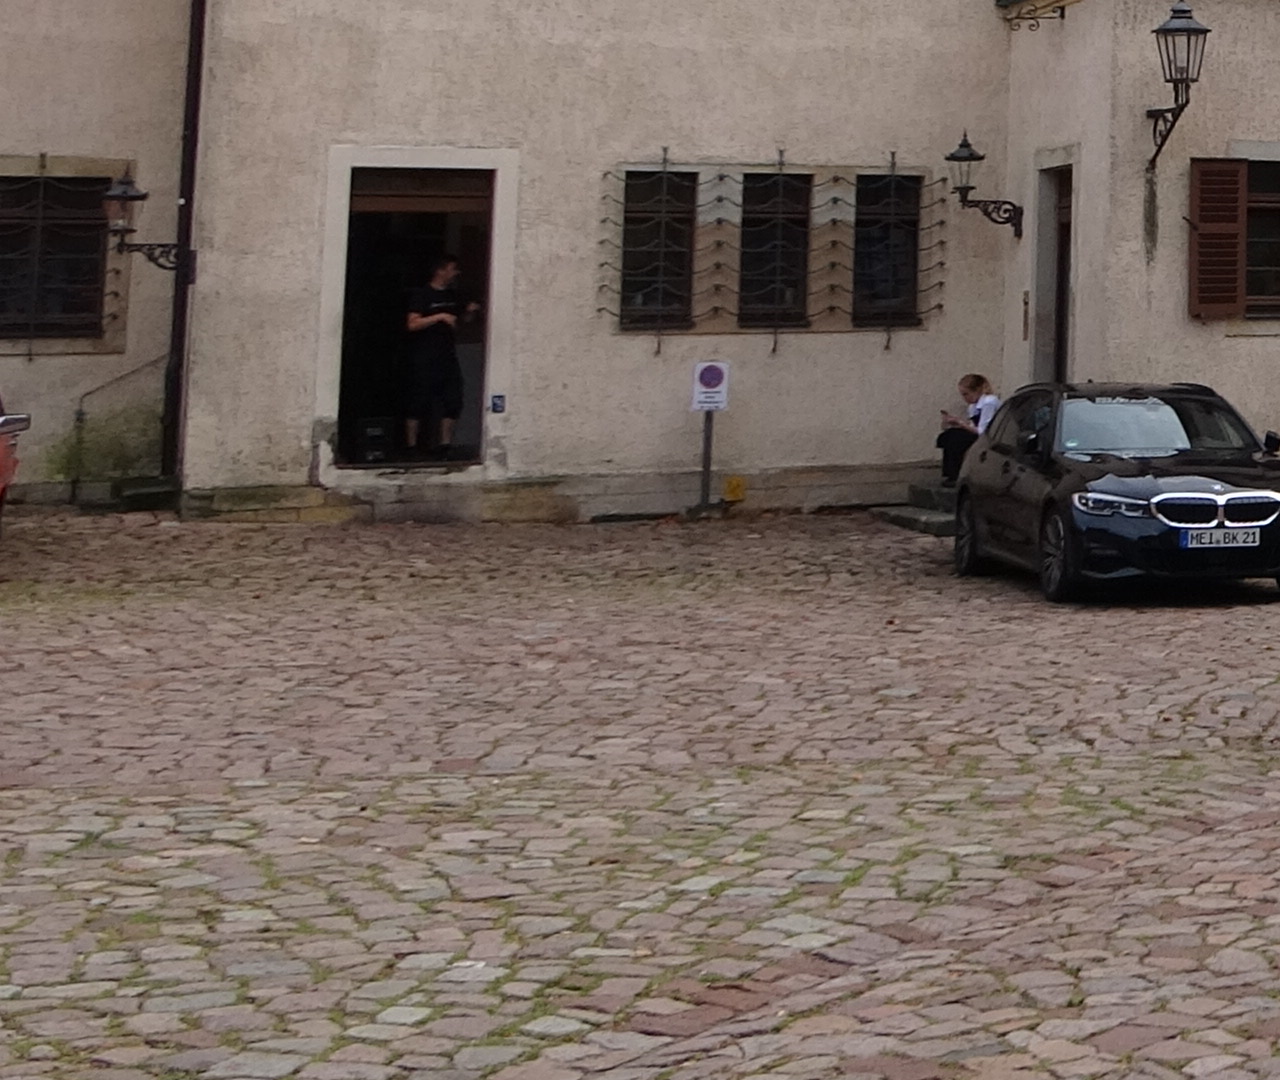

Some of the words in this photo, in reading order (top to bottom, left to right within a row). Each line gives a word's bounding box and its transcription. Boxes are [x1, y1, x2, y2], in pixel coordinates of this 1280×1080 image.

[1190, 532, 1214, 545] MEI
[1223, 531, 1240, 544] BK
[1242, 531, 1257, 544] 21
